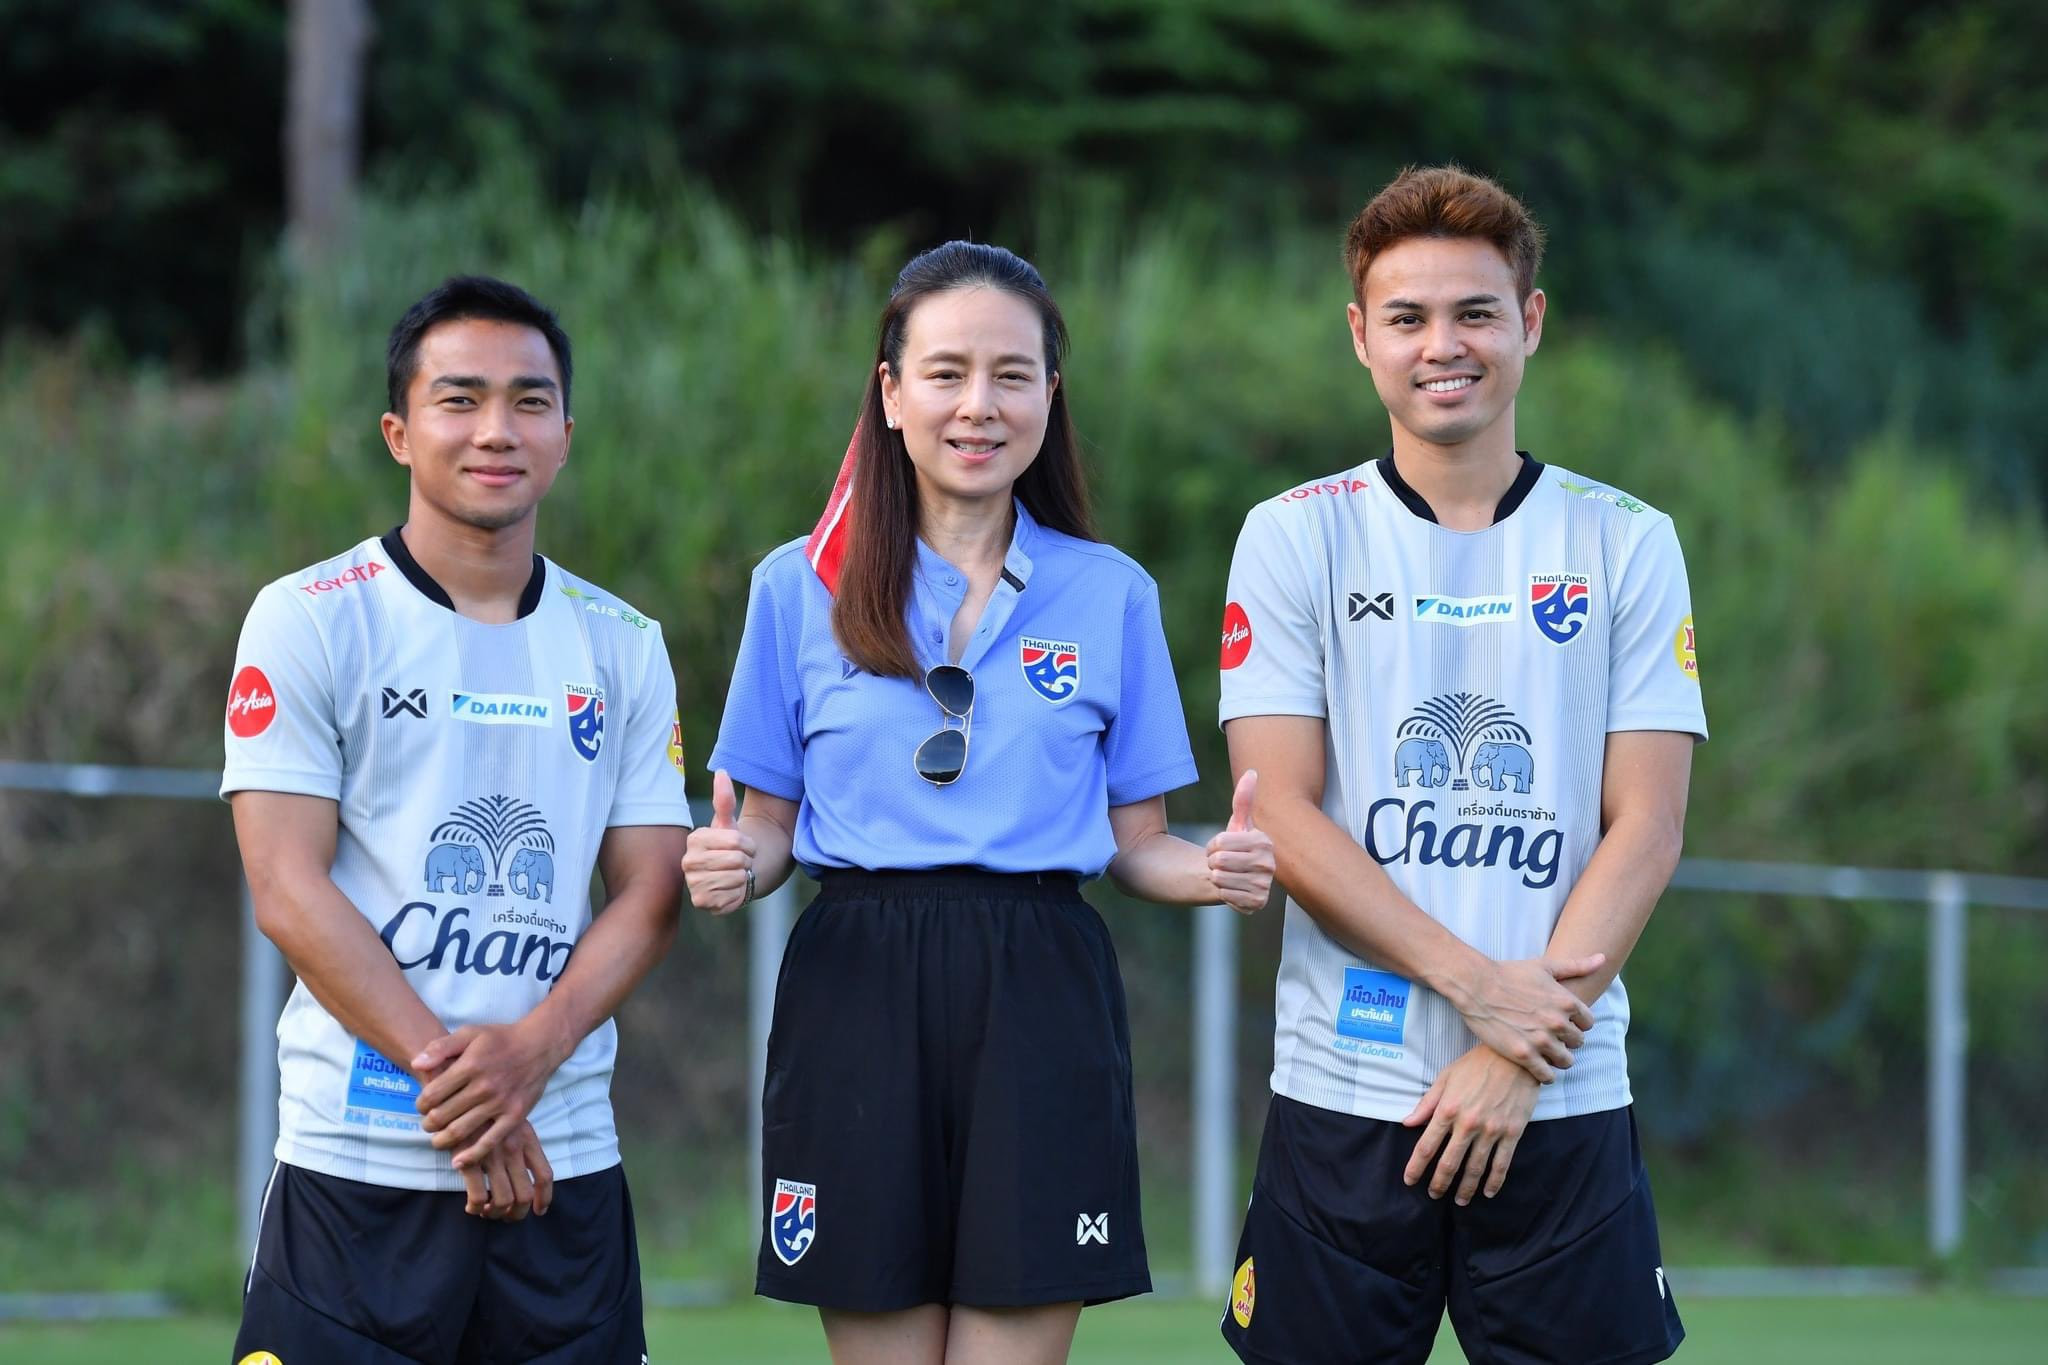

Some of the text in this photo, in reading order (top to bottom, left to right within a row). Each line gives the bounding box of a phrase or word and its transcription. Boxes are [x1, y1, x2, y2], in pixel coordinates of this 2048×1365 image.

[1276, 480, 1368, 502] TOYOTA
[300, 561, 386, 595] TOYOTA
[1532, 575, 1587, 584] THAILAND
[1437, 602, 1512, 618] DAIKIN
[1022, 639, 1076, 653] THAILAND
[471, 701, 547, 718] DAIKIN
[1458, 800, 1556, 821] เครื่องดื่มตราช้าง
[1365, 797, 1564, 889] Chang
[1345, 985, 1405, 1009] เมืองไทย
[779, 1182, 814, 1197] THAILAND
